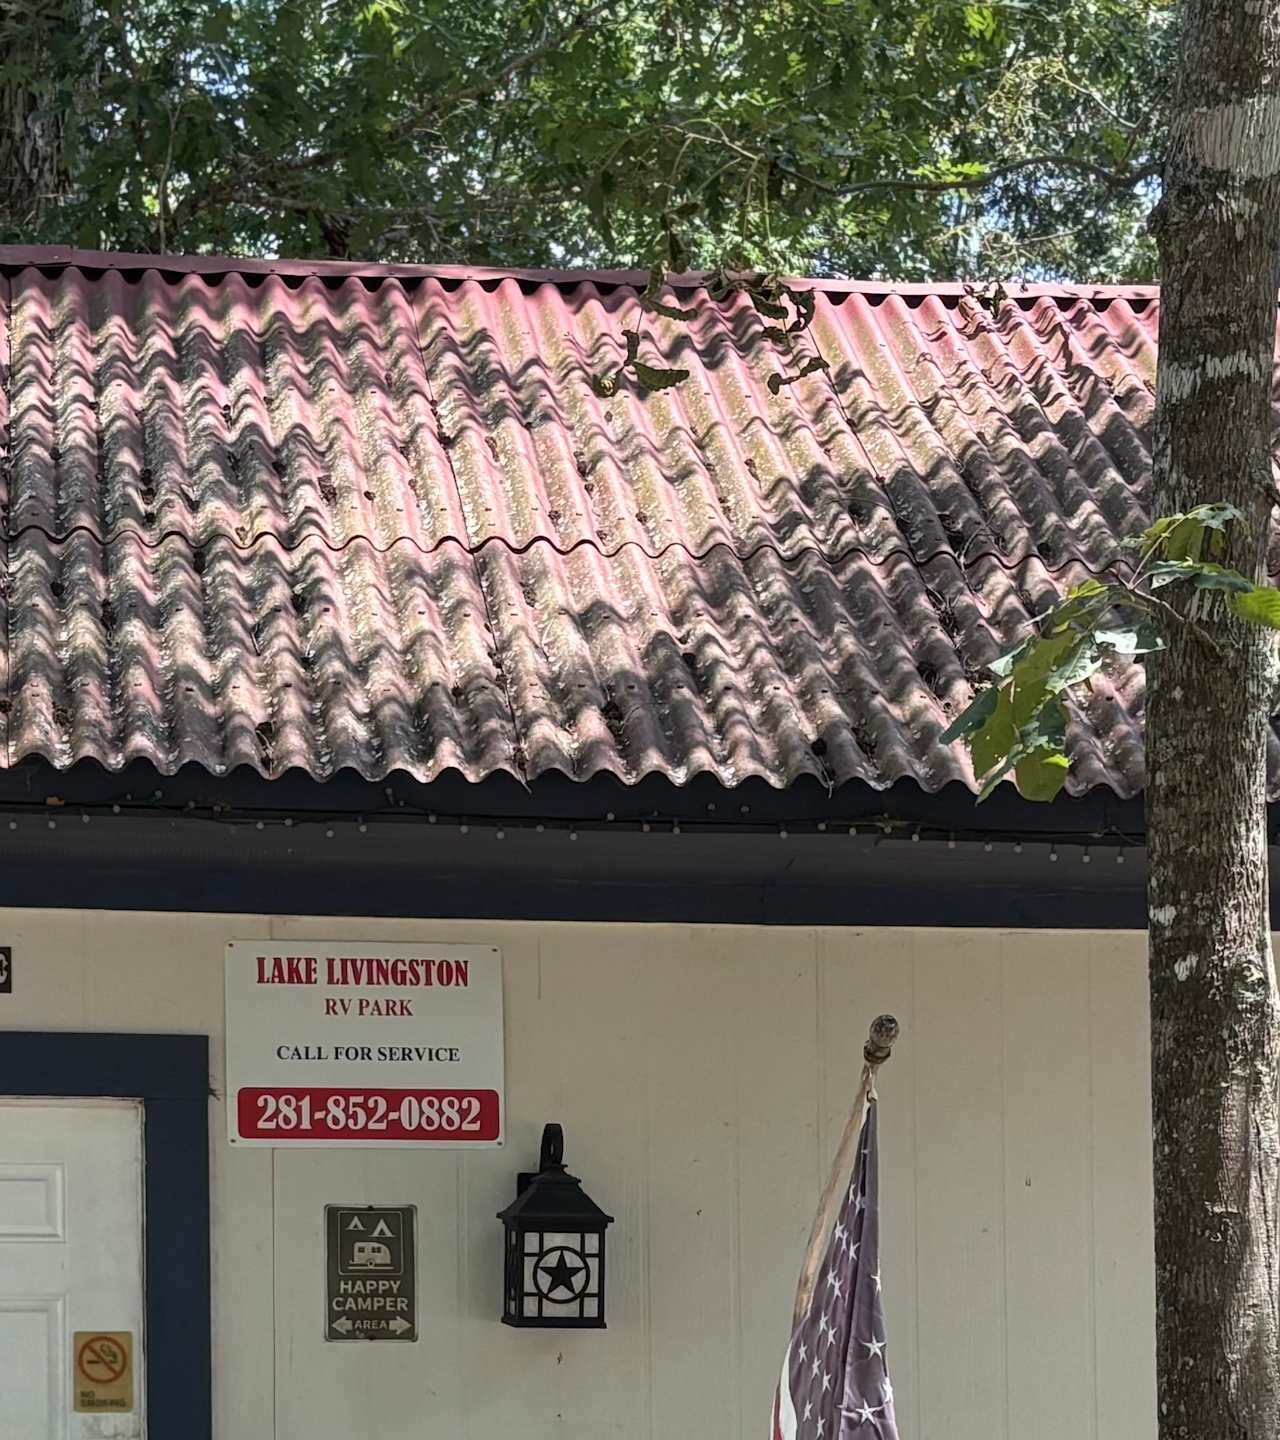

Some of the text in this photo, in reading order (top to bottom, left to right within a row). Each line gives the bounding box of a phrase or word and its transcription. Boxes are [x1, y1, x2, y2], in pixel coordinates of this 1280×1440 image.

[256, 956, 469, 987] LAKE LIVINGSTON
[324, 998, 413, 1017] RV PARK
[276, 1045, 460, 1062] CALL FOR SERVICE
[256, 1094, 481, 1131] 281-852-0882
[339, 1280, 401, 1294] HAPPY
[332, 1297, 409, 1311] CAMPER
[354, 1319, 388, 1330] AREA
